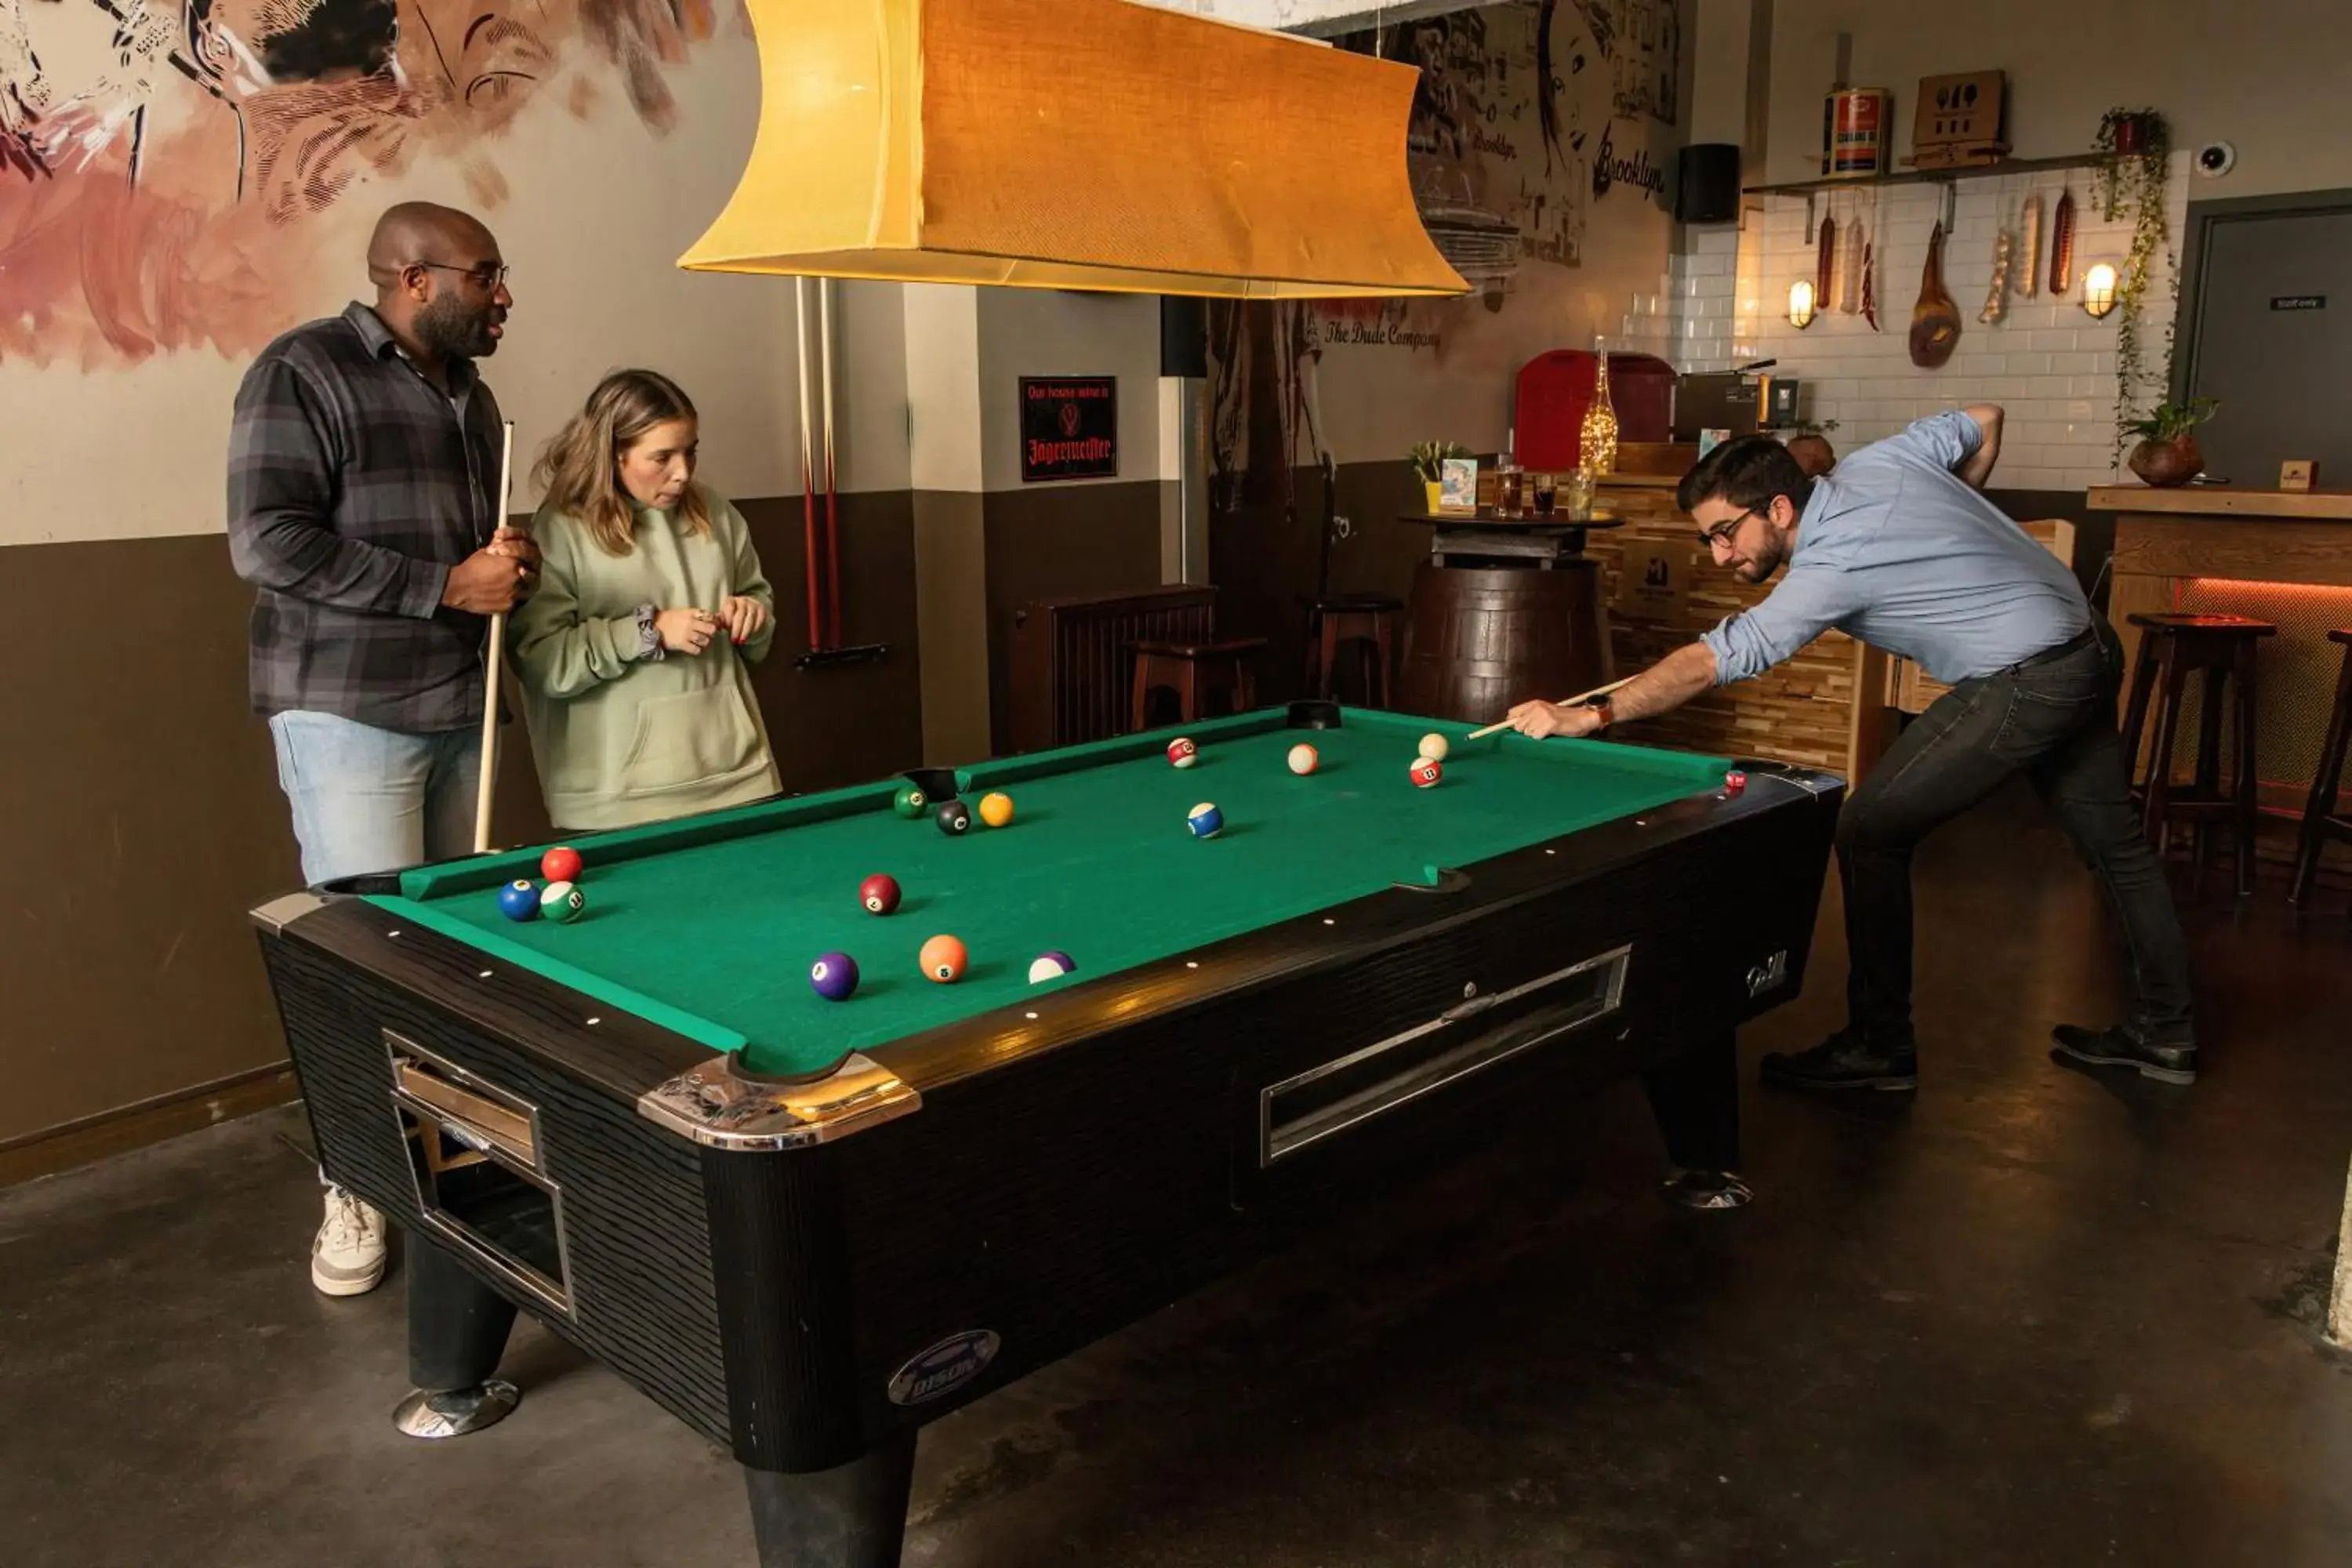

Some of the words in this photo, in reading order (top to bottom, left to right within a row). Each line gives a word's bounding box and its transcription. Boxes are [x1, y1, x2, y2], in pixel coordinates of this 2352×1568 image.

[1473, 125, 1517, 162] Brooklyn
[1596, 140, 1664, 201] Brooklyn
[1324, 321, 1348, 343] The
[1351, 318, 1385, 345] Dude
[1388, 323, 1441, 354] Company
[1028, 385, 1045, 400] Our
[1047, 386, 1075, 398] house
